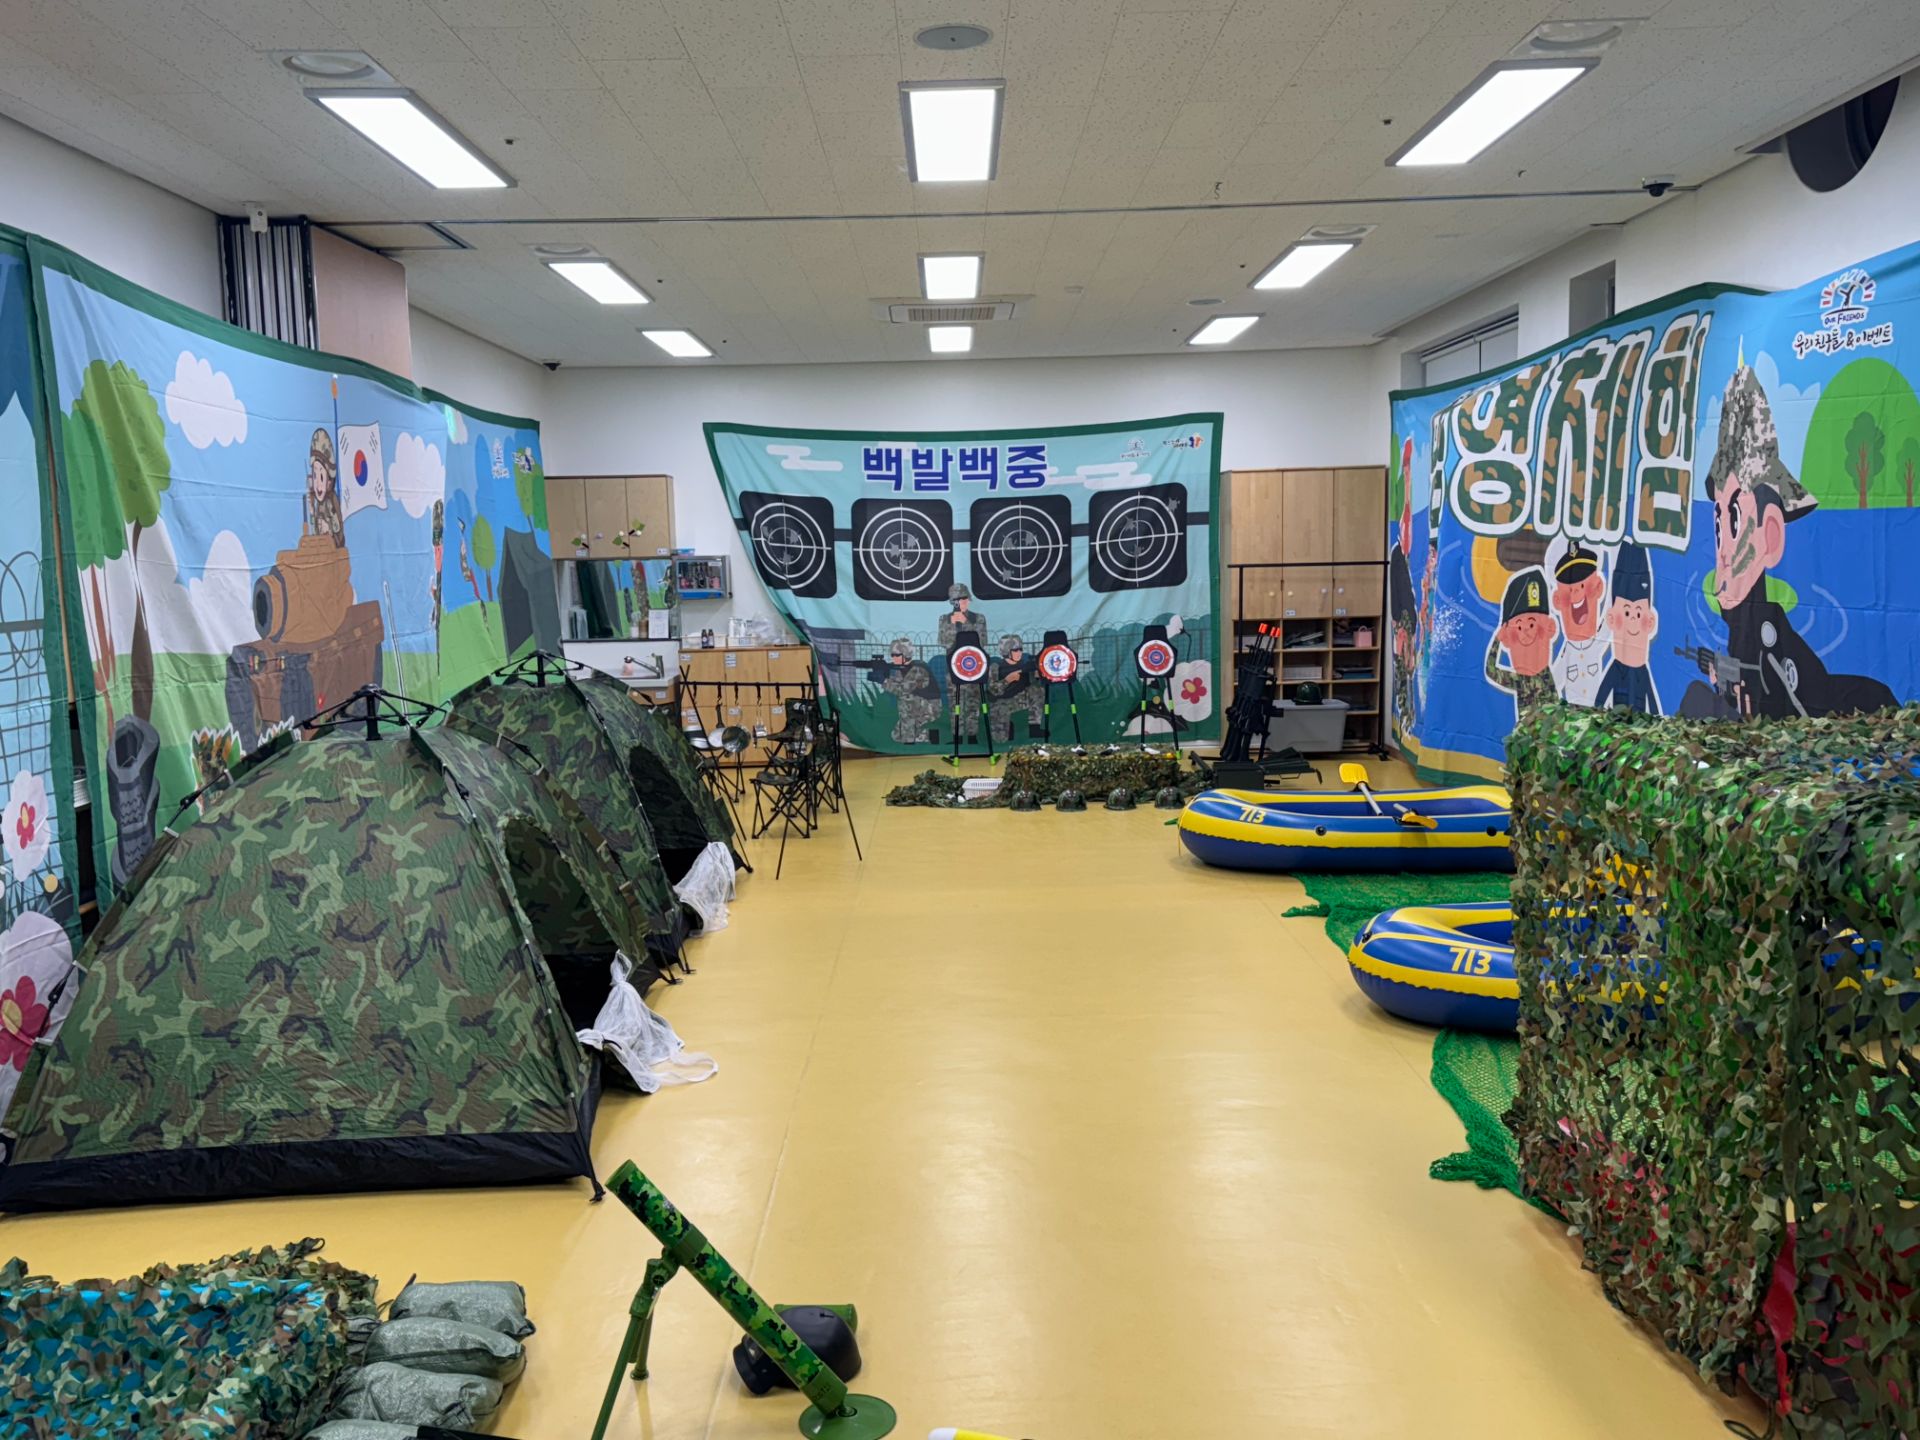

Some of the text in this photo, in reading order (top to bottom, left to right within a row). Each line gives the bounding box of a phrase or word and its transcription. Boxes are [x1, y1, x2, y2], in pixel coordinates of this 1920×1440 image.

[1837, 312, 1865, 324] FRIENDS
[1430, 312, 1712, 552] 영체험
[863, 444, 1048, 492] 백발백중
[1238, 805, 1268, 824] 713
[1449, 947, 1492, 975] 713
